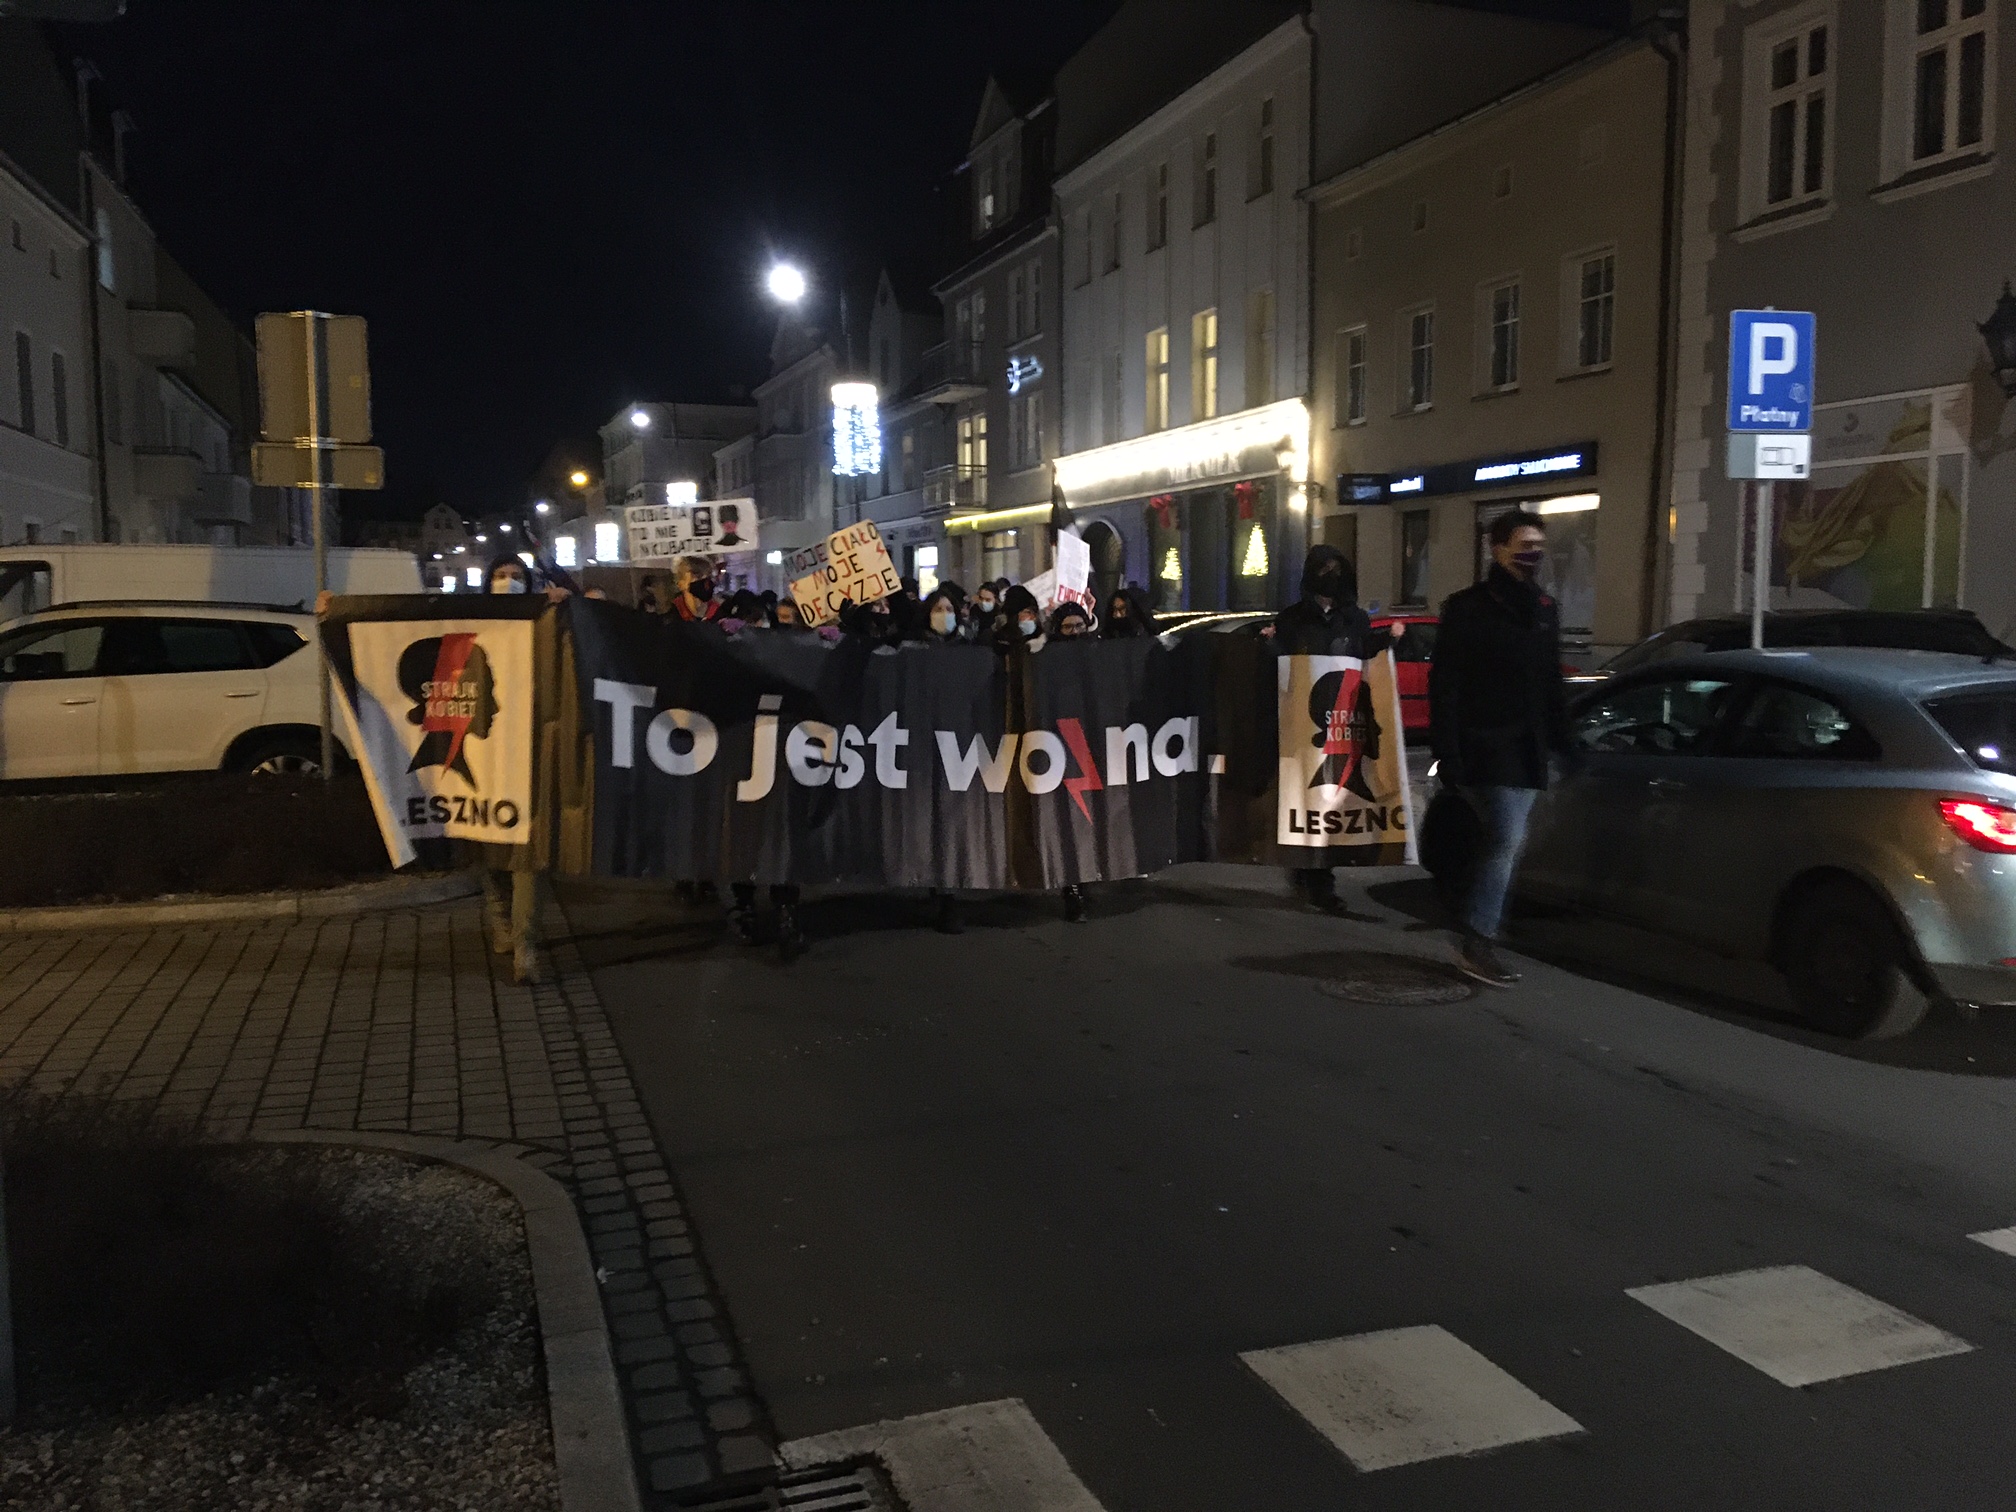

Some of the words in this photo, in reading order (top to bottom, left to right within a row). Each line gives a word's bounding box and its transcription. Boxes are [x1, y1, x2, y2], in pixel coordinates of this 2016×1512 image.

[1748, 322, 1798, 395] P
[783, 543, 828, 577] MOJE
[812, 553, 864, 591] MOJE
[801, 567, 899, 624] DECYZJE
[420, 681, 479, 699] STRAJK
[425, 700, 477, 718] KOBIET
[593, 678, 719, 777] To
[736, 693, 910, 803] jest
[402, 796, 519, 828] ESZNO
